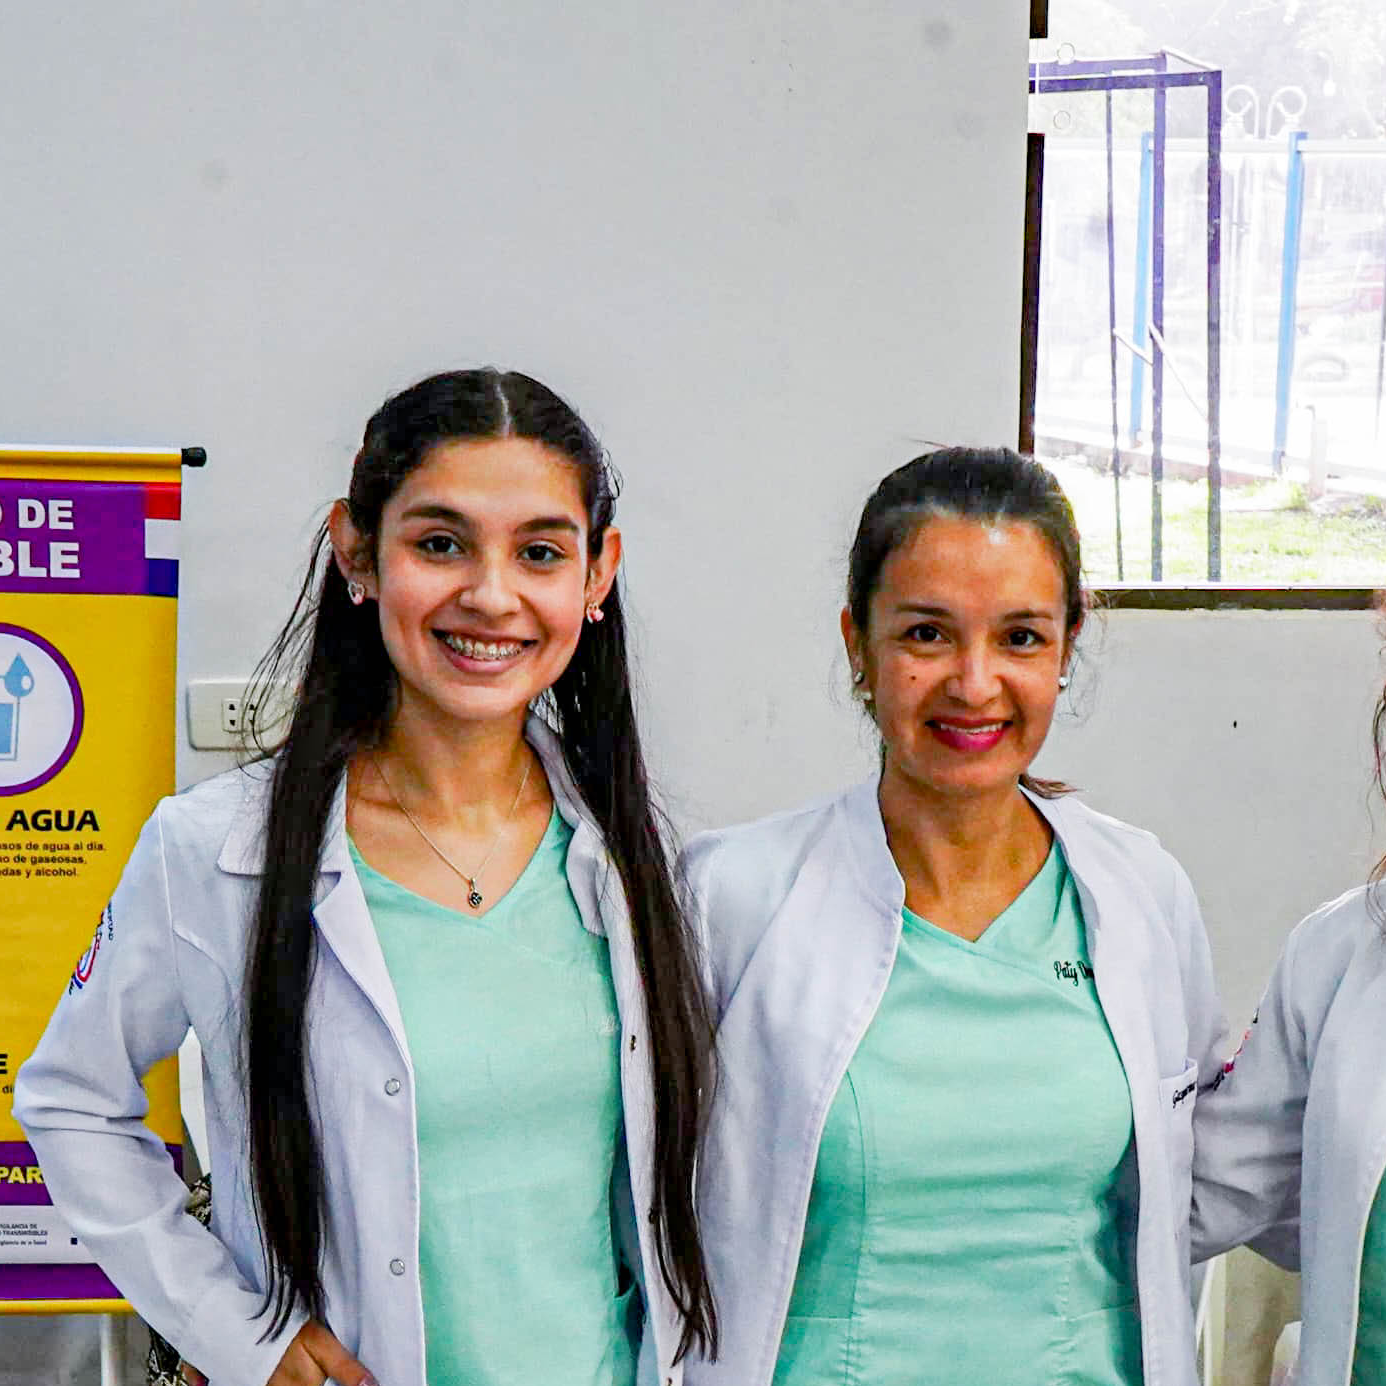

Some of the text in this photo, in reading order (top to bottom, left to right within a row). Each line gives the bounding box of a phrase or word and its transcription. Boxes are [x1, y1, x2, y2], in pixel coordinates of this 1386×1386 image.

[17, 499, 74, 530] DE
[5, 807, 100, 832] AGUA
[42, 842, 71, 853] agua
